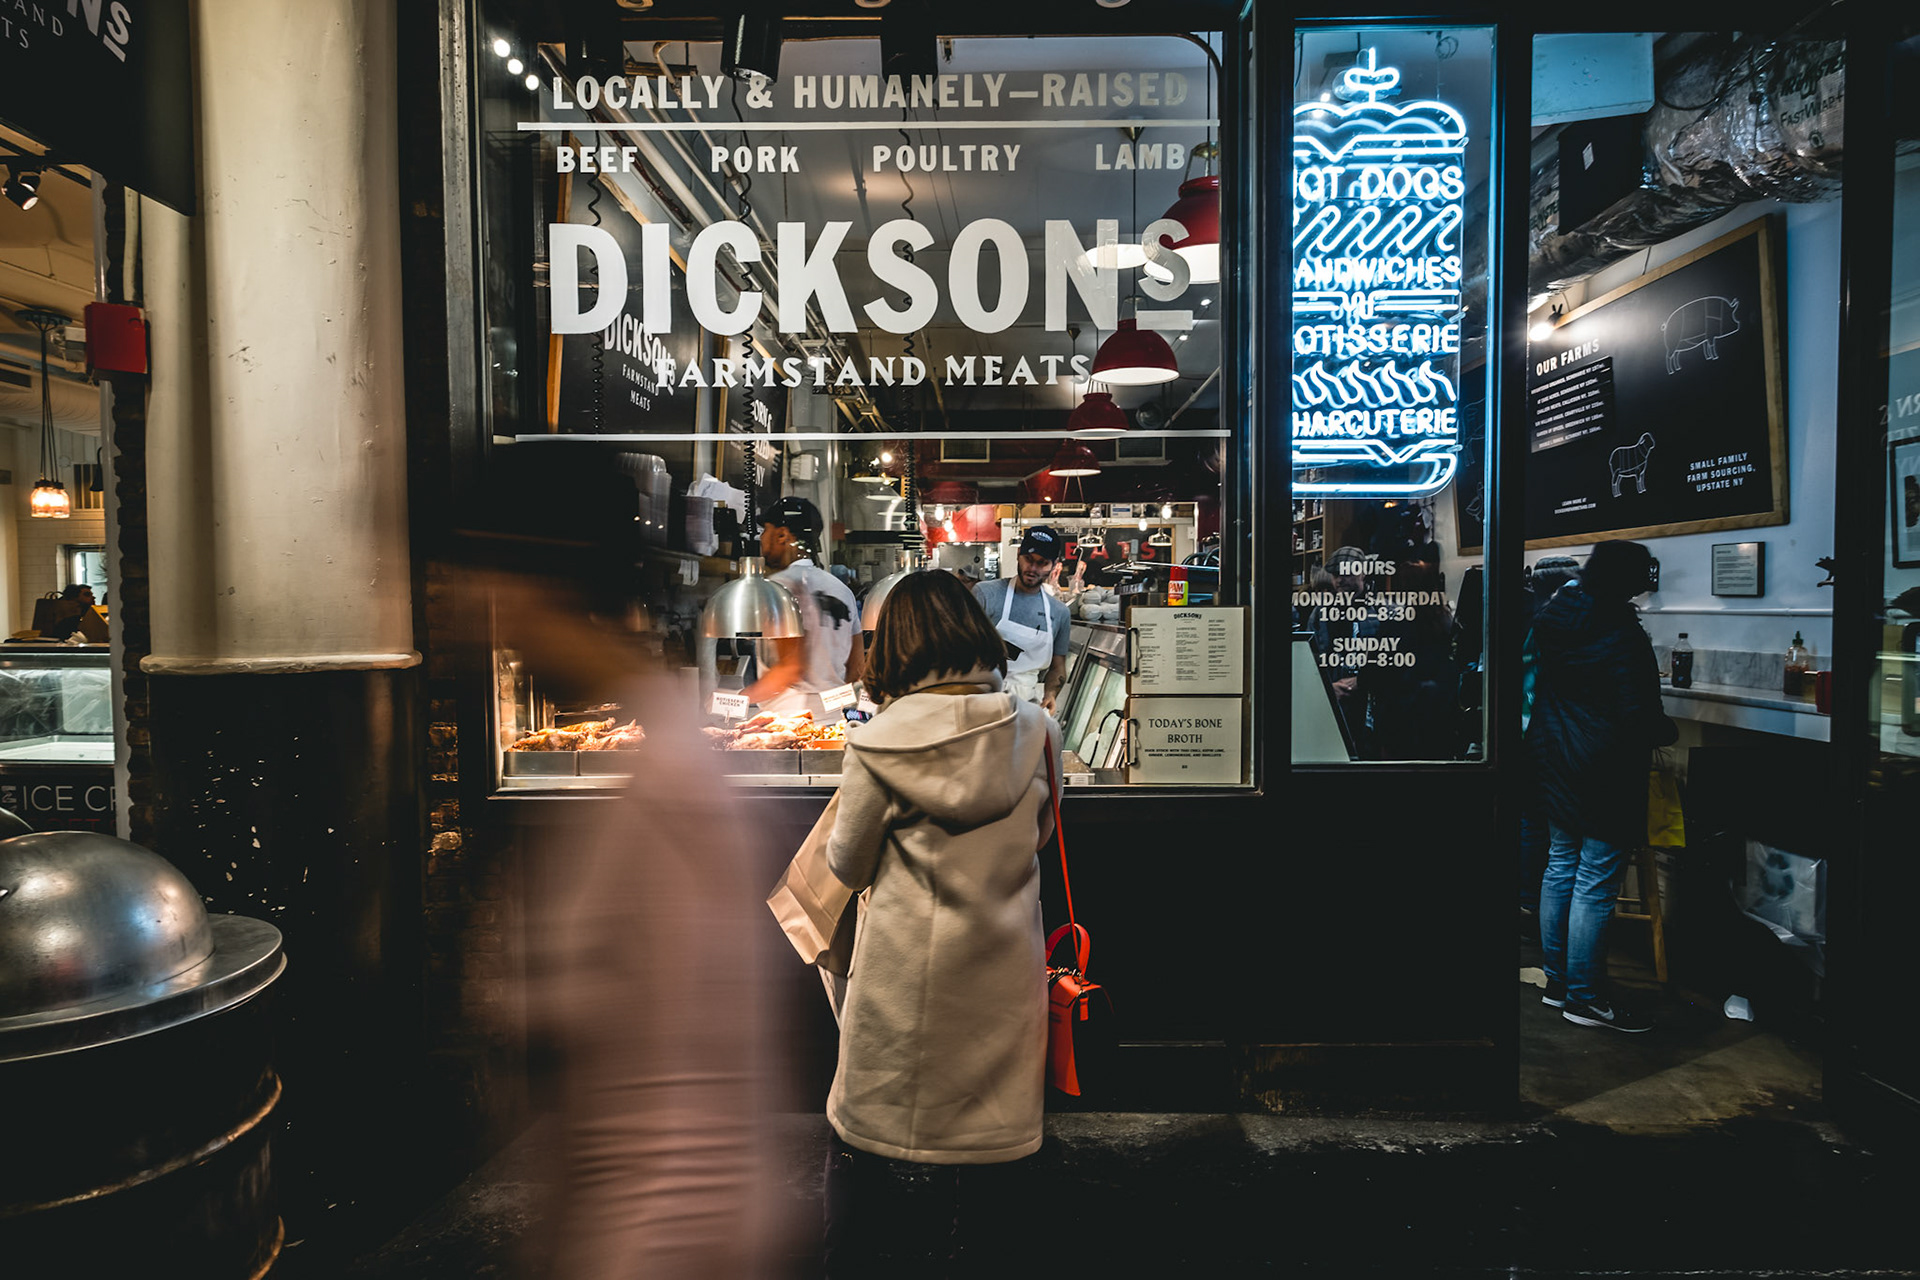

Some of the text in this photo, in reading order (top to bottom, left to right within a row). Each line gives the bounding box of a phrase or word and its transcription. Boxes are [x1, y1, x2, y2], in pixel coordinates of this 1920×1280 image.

[552, 75, 725, 110] LOCALLY
[745, 74, 774, 109] &
[556, 143, 1186, 173] BEEF PORK POULTRY LAMB
[1293, 166, 1465, 201] OT DOGS
[548, 218, 1194, 335] DICKSONS
[1294, 256, 1463, 284] ANDWICHES
[1294, 324, 1460, 354] OTISSERIE
[1536, 338, 1600, 377] OUR FARMS
[655, 355, 1090, 388] FARMSTAND MEATS
[630, 389, 651, 411] MEATS
[1292, 407, 1459, 436] HARCUTERIE
[1686, 463, 1757, 483] FARM SOURCING.
[1689, 452, 1748, 471] SMALL FAMILY
[1696, 477, 1745, 493] UPSTATE NY
[1339, 561, 1396, 576] HOURS
[1168, 582, 1184, 593] PAM
[1333, 637, 1401, 652] SUNDAY
[1148, 718, 1223, 729] TODAY'S BONE
[1167, 733, 1203, 744] BROTH
[22, 785, 75, 811] ICE
